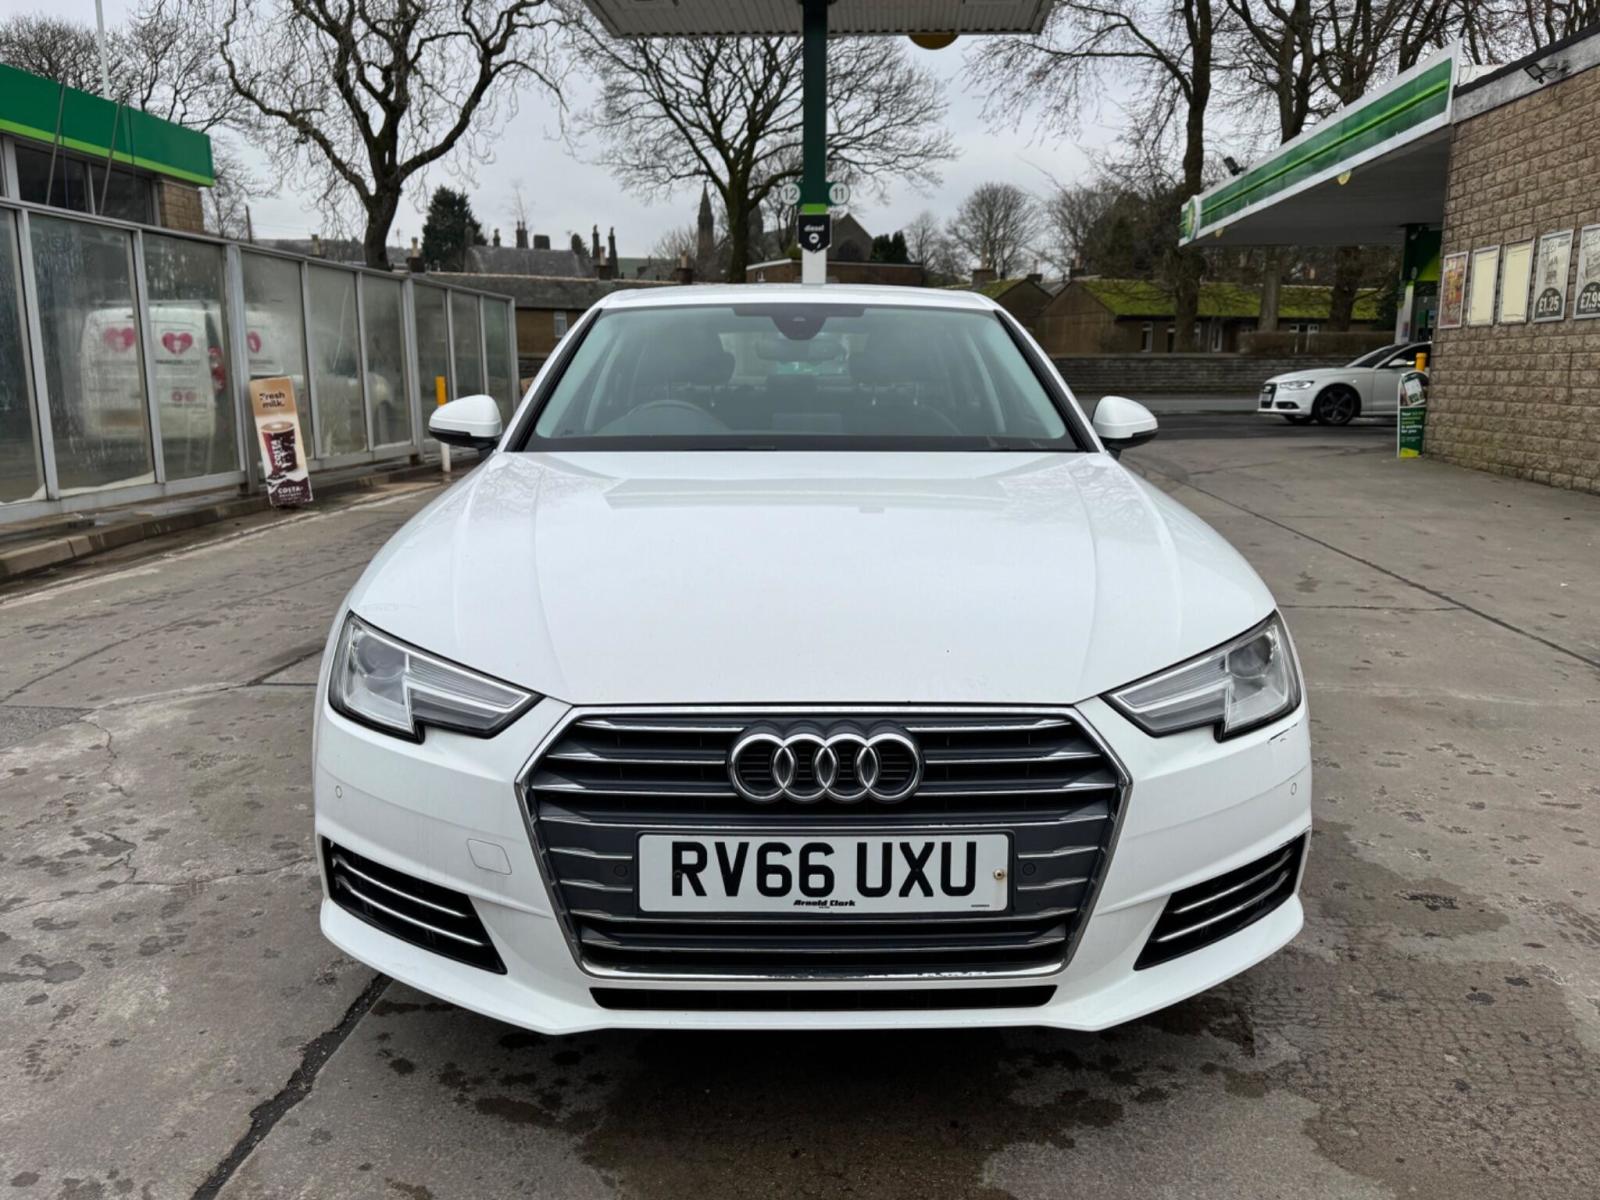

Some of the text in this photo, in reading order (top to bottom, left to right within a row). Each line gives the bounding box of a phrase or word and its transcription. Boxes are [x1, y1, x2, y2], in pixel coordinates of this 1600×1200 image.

[783, 188, 797, 200] 12
[833, 187, 845, 200] 11
[1538, 295, 1560, 313] £1.25
[259, 391, 285, 400] Fresh
[671, 841, 977, 897] RV66 UXU
[793, 899, 856, 907] Arnold Clark
